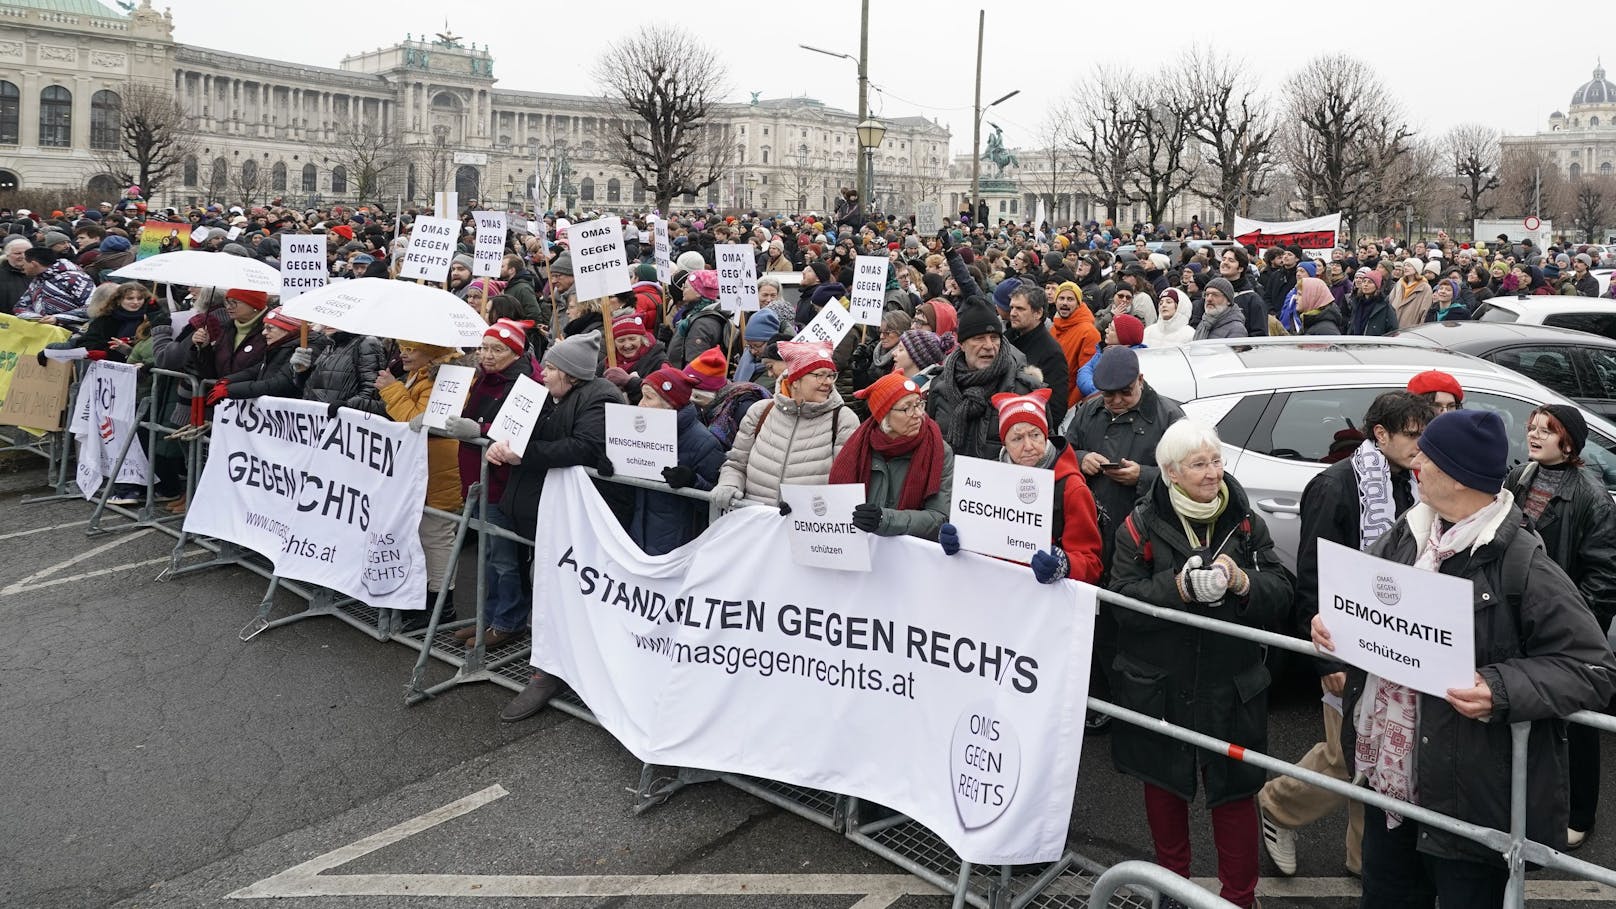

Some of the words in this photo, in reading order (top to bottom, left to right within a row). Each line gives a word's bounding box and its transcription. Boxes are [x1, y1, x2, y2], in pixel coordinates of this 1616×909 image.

[421, 224, 450, 236] OMAS
[481, 219, 501, 229] OMAS
[581, 226, 611, 239] OMAS
[414, 238, 449, 251] GEGEN
[479, 235, 502, 245] GEGEN
[290, 244, 319, 254] OMAS
[581, 243, 616, 256] GEGEN
[407, 253, 449, 266] RECHTS
[475, 250, 502, 261] RECHTS
[286, 261, 321, 270] GEGEN
[580, 259, 621, 273] RECHTS
[861, 265, 881, 275] OMAS
[722, 270, 751, 278] GEGN
[283, 277, 324, 287] RECHTS
[857, 281, 881, 292] GEGEN
[721, 285, 756, 294] RECTS
[853, 297, 881, 308] RECHTS
[826, 310, 845, 332] OMAS
[811, 323, 832, 343] GEGE
[608, 437, 674, 453] MENSCHENRECHTE
[626, 457, 656, 467] schützen
[228, 451, 296, 500] GEGEN
[965, 477, 982, 489] Aus
[959, 499, 1043, 528] GESCHICHTE
[794, 520, 857, 534] DEMOKRATIE
[1007, 535, 1036, 551] lernen
[810, 544, 843, 555] schützen
[1376, 575, 1394, 583] OMAS
[1377, 583, 1397, 592] GEGEN
[1377, 591, 1399, 600] RECHTS
[1333, 594, 1453, 647] DEMOKRATIE
[777, 604, 894, 654] GEGEN
[906, 625, 1039, 694] RECHTS
[1358, 637, 1421, 669] schützen
